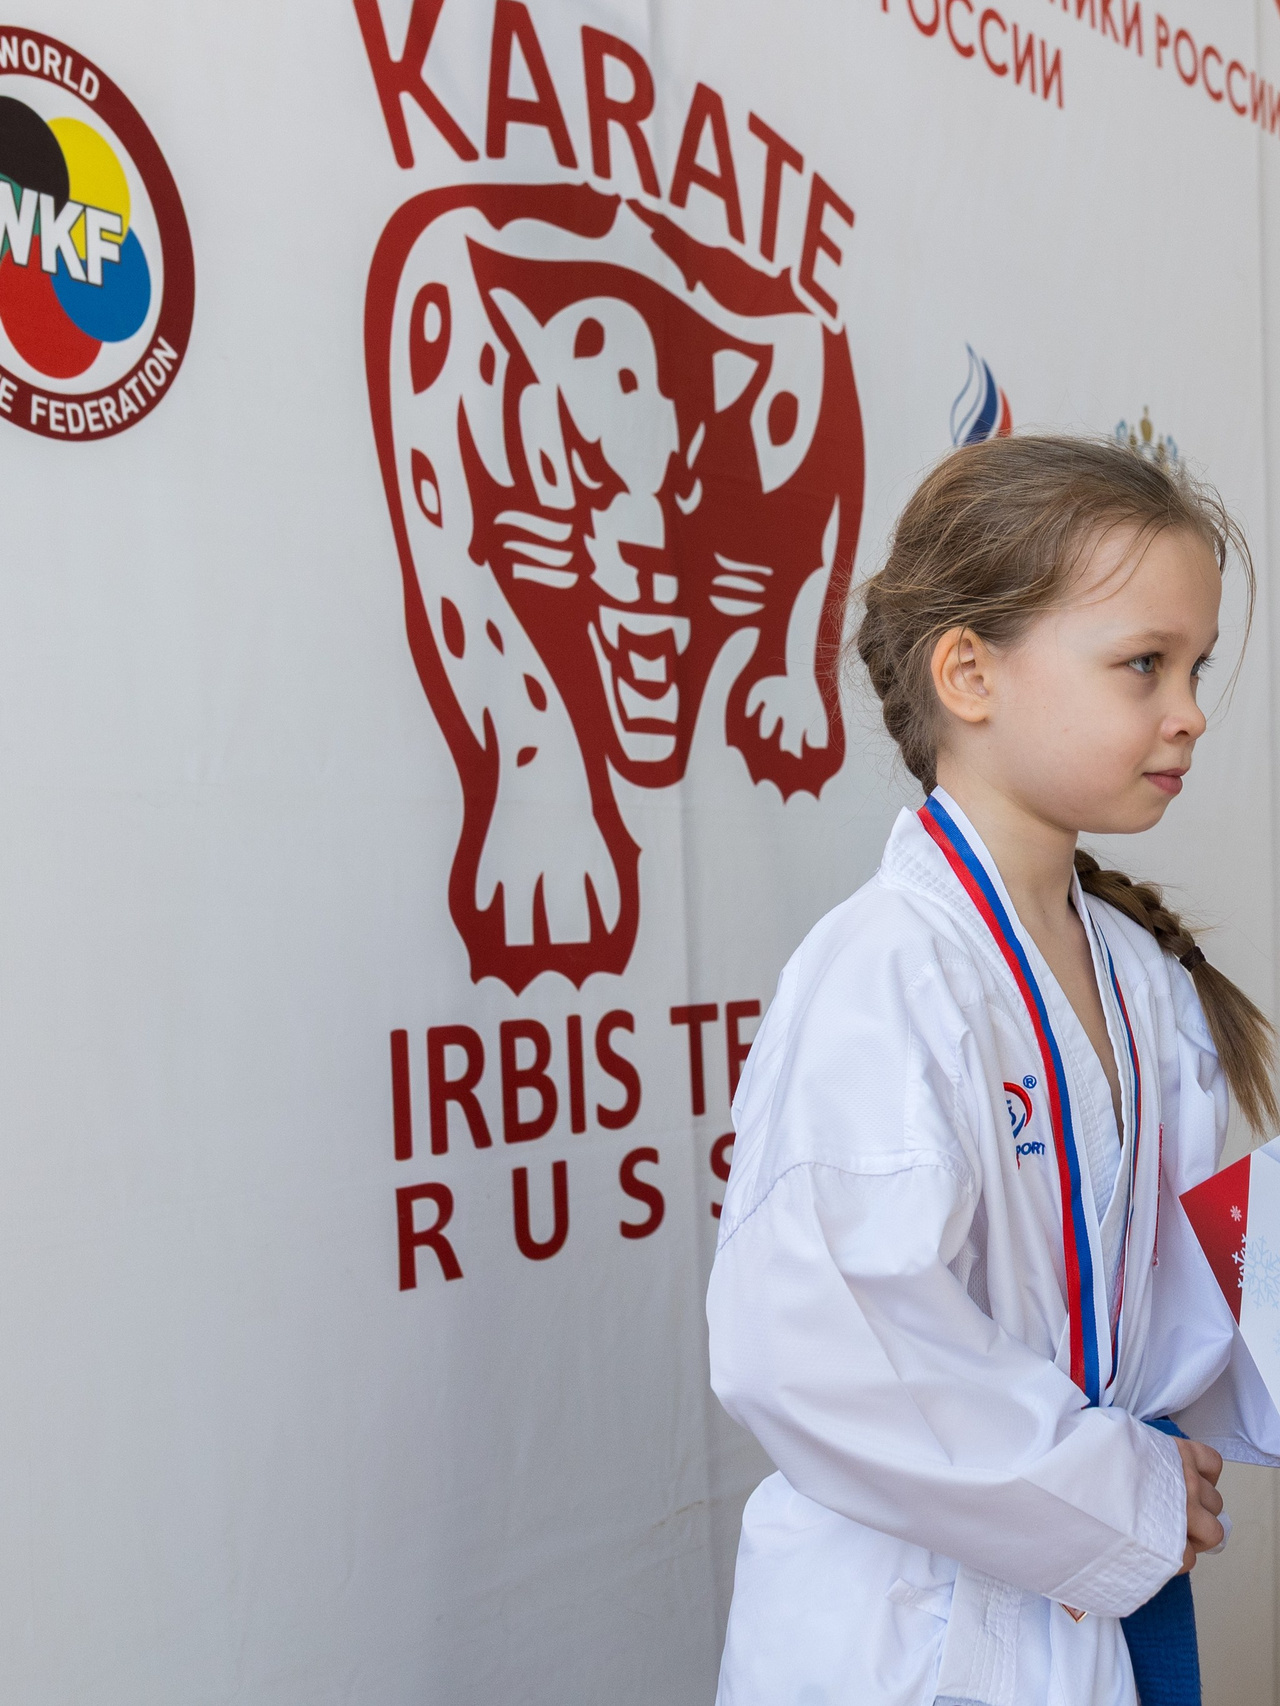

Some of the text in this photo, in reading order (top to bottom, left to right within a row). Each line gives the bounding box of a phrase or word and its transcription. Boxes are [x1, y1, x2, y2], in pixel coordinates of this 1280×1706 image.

[0, 36, 99, 101] WORLD
[881, 0, 1064, 109] ОССИИ
[354, 0, 855, 320] KARATE
[0, 179, 122, 287] WKF
[30, 336, 178, 434] FEDERATION
[391, 999, 761, 1161] IRBIS TE
